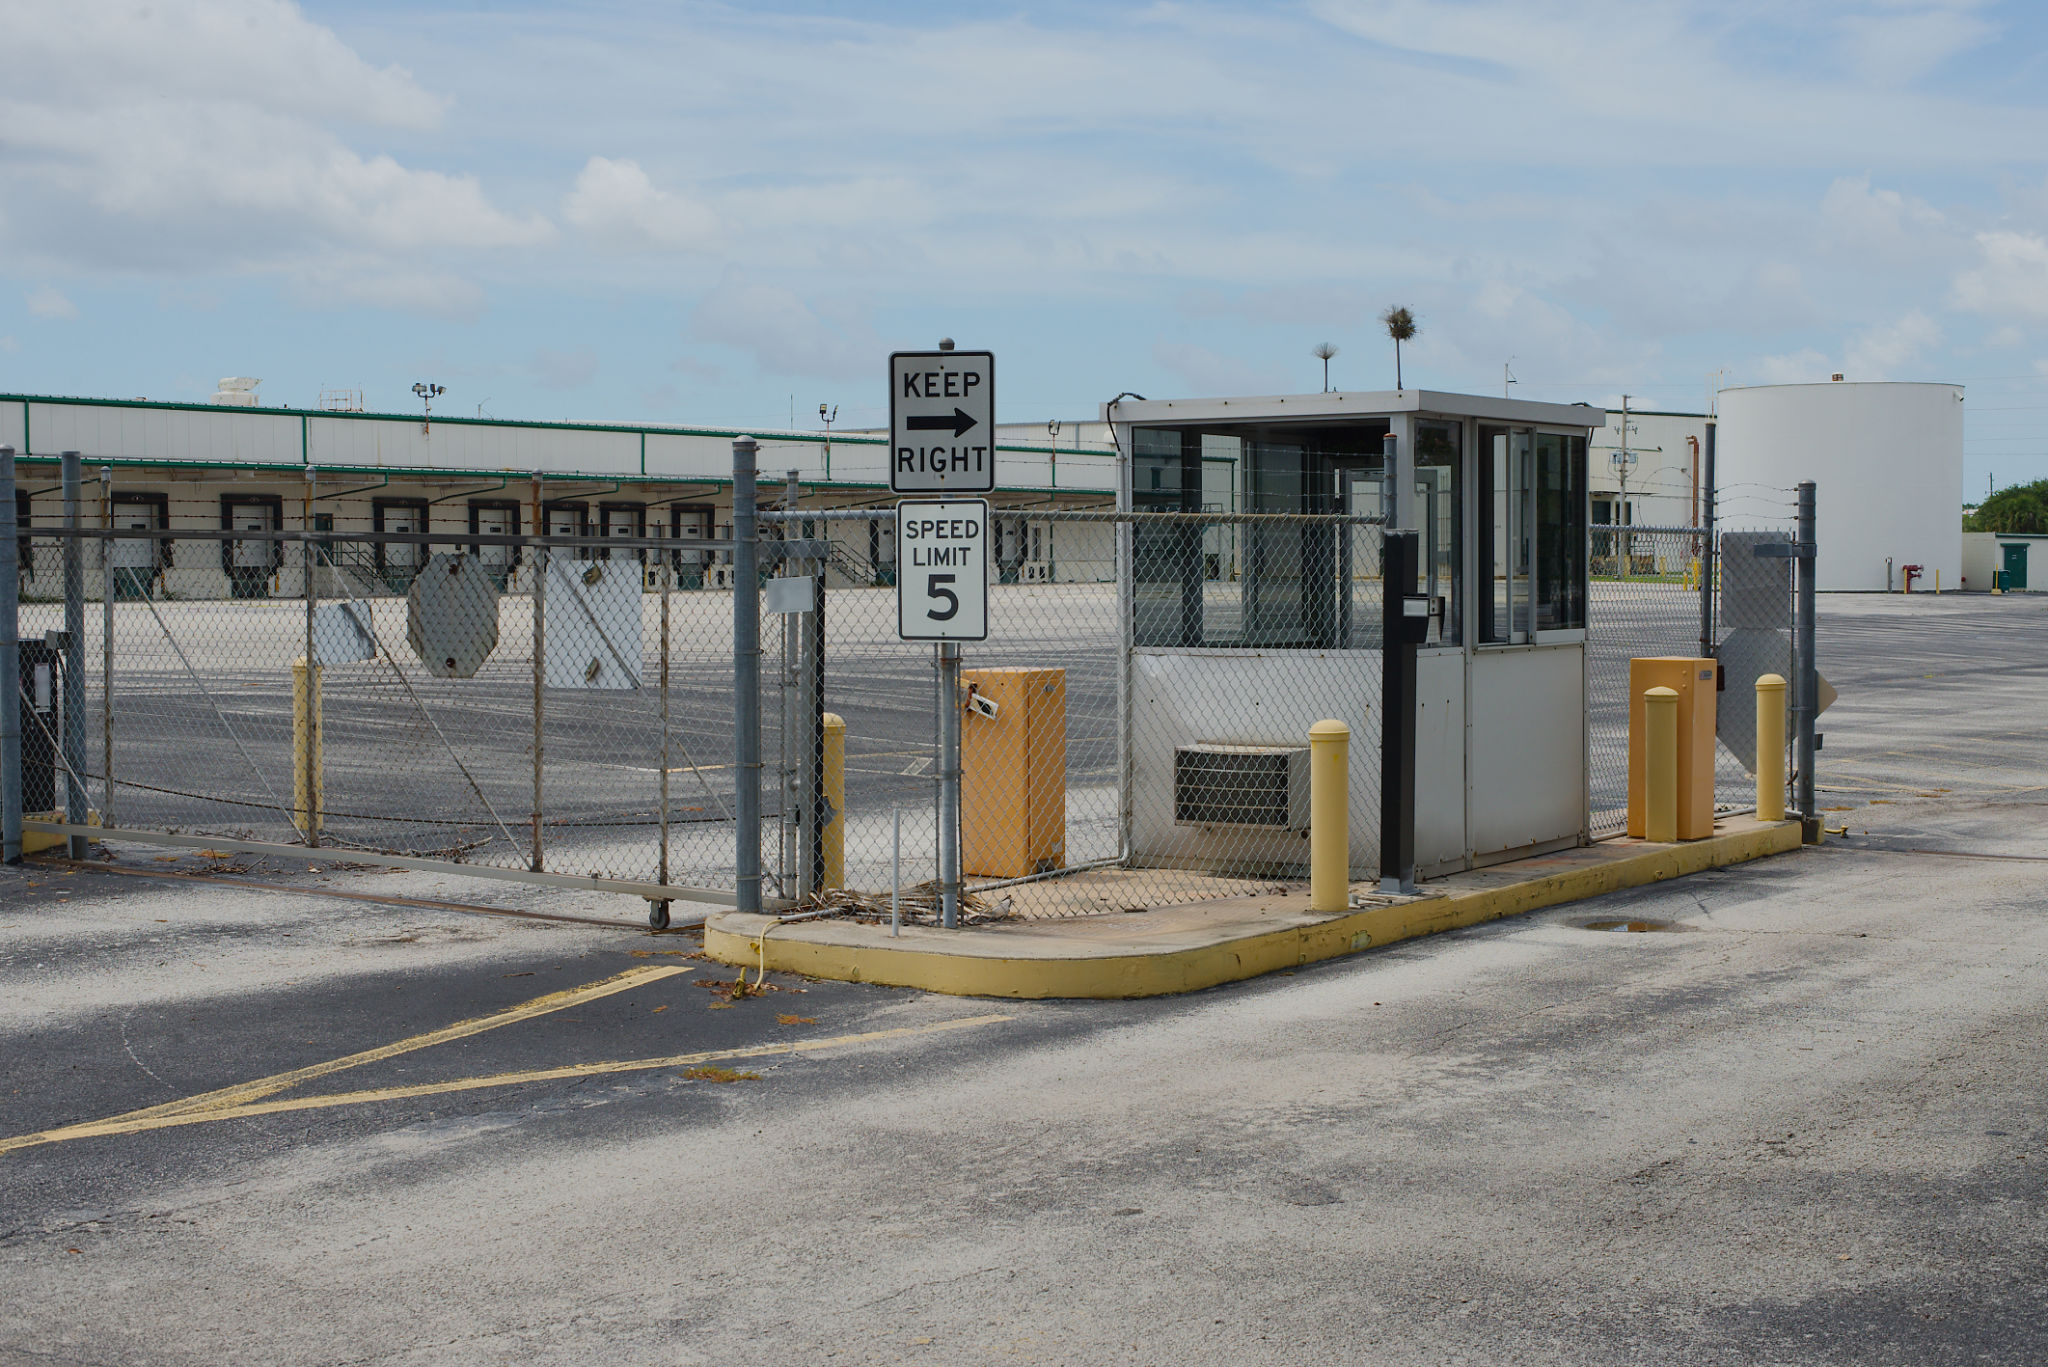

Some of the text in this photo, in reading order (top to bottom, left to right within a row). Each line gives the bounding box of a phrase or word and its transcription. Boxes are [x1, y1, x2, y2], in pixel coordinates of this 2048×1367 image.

[904, 372, 981, 398] KEEP
[897, 446, 987, 473] RIGHT
[906, 520, 979, 539] SPEED
[913, 547, 971, 566] LIMIT
[927, 574, 959, 621] 5
